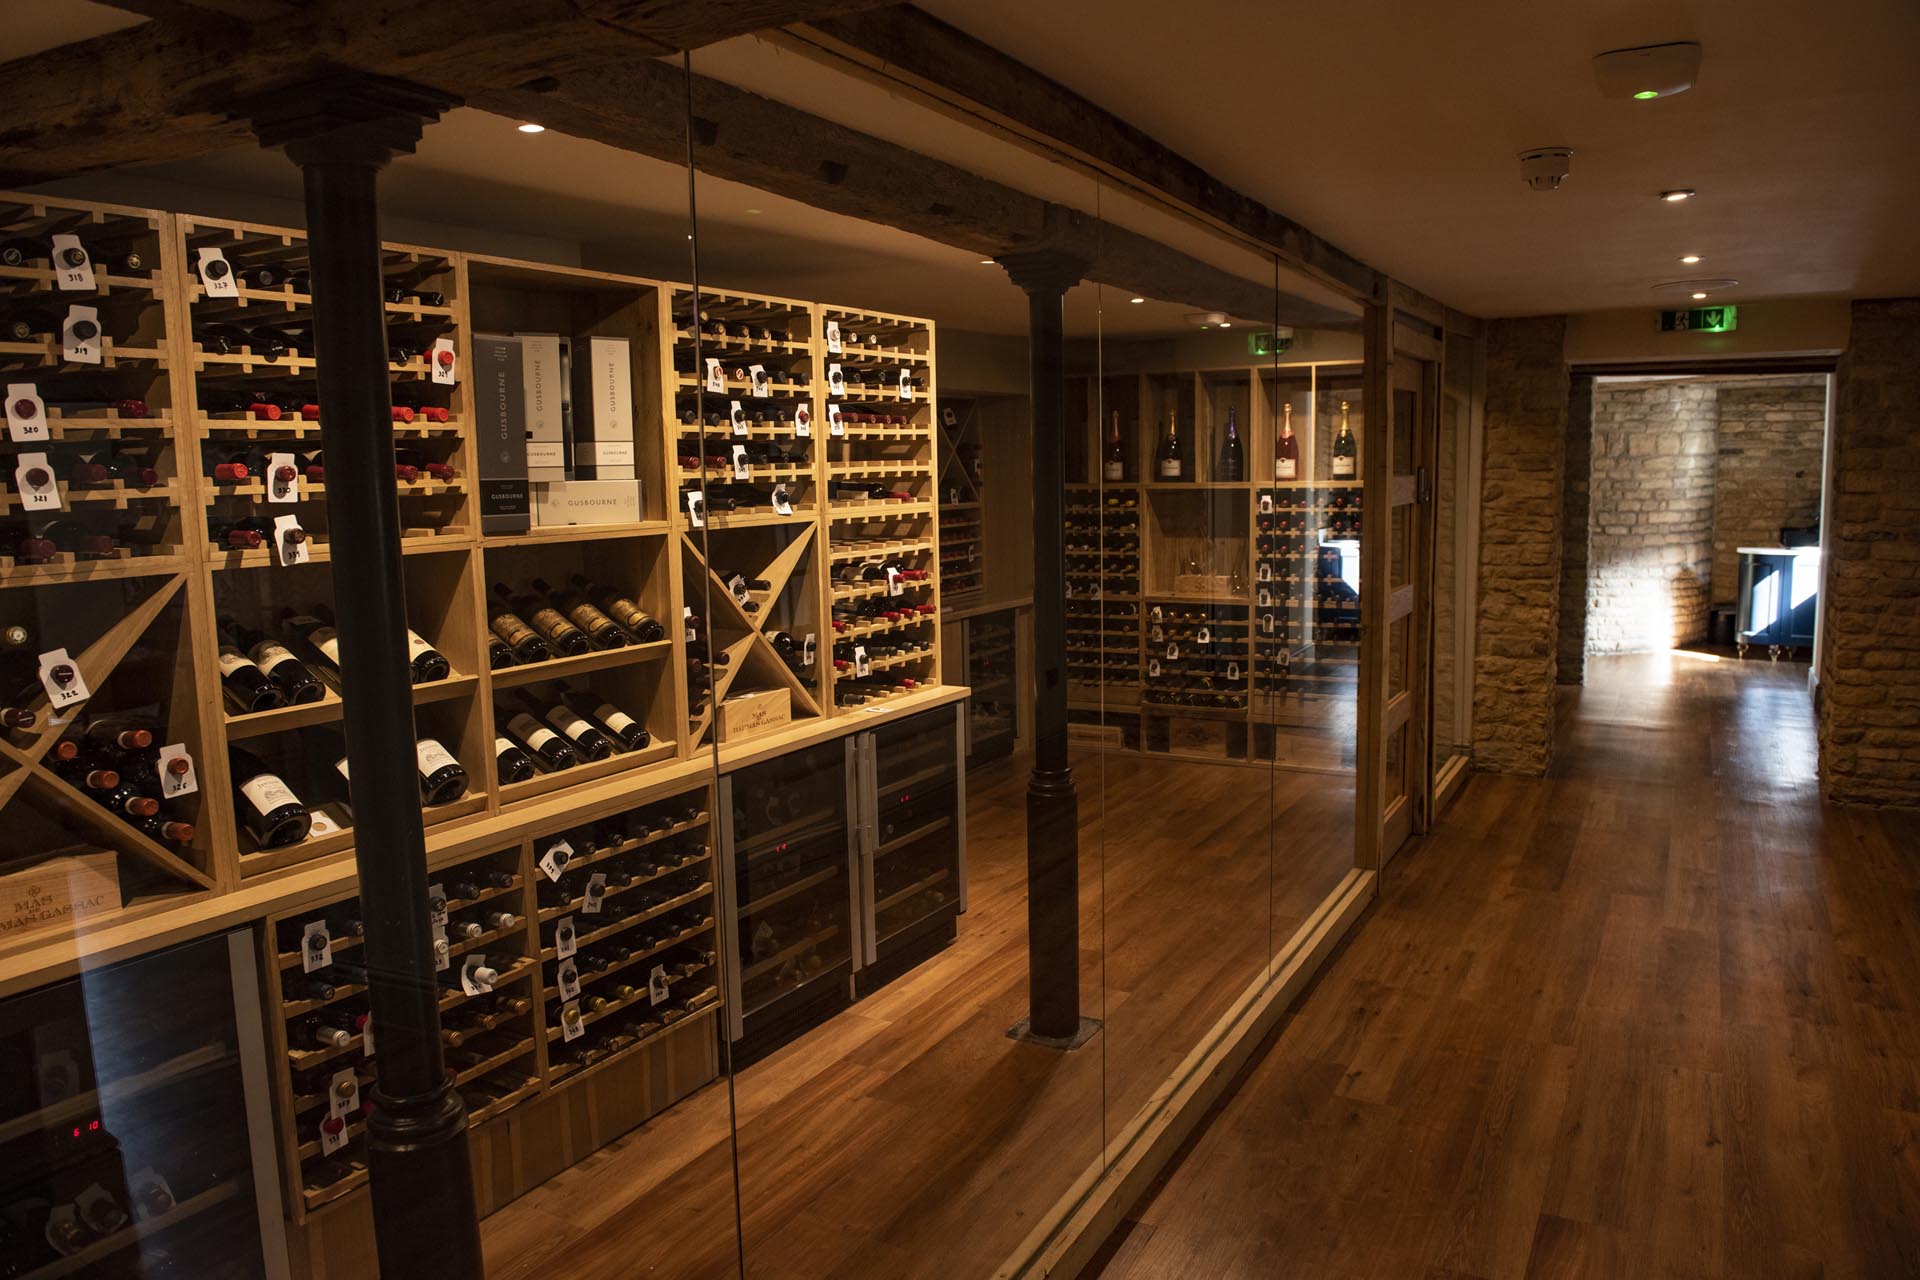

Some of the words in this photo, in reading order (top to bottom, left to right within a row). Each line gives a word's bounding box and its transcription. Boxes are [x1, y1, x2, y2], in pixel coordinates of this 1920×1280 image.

[68, 273, 84, 282] 318
[214, 282, 228, 290] 327
[74, 347, 88, 355] 319
[536, 359, 544, 412] GUSBOURNE
[609, 361, 617, 413] GUSBOURNE
[498, 371, 508, 440] GUSBOURNE
[23, 426, 39, 434] 320
[33, 495, 48, 503] 321
[491, 492, 524, 500] GUSBOURNE
[567, 498, 617, 507] GUSBOURNE
[60, 690, 79, 700] 322
[14, 895, 53, 914] MAS
[73, 1127, 80, 1137] 6
[88, 1120, 99, 1132] 10
